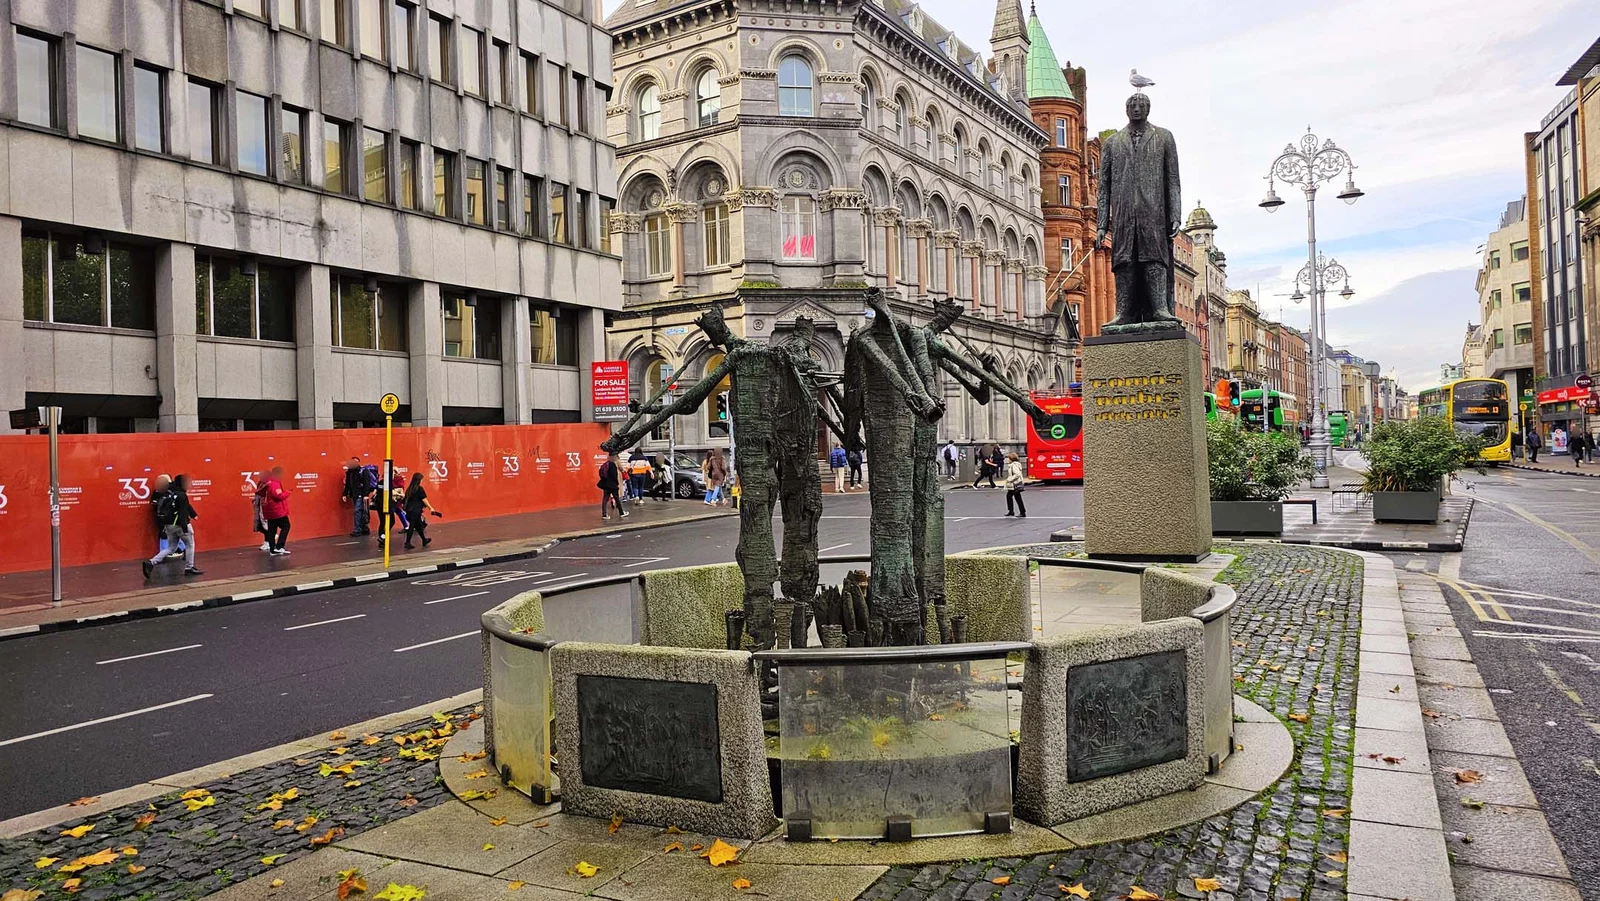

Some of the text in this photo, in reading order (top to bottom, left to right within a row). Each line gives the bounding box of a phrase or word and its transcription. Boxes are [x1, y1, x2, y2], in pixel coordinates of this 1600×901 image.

[502, 456, 519, 472] 33
[566, 452, 581, 467] 33
[429, 460, 448, 478] 33
[118, 478, 151, 499] 33
